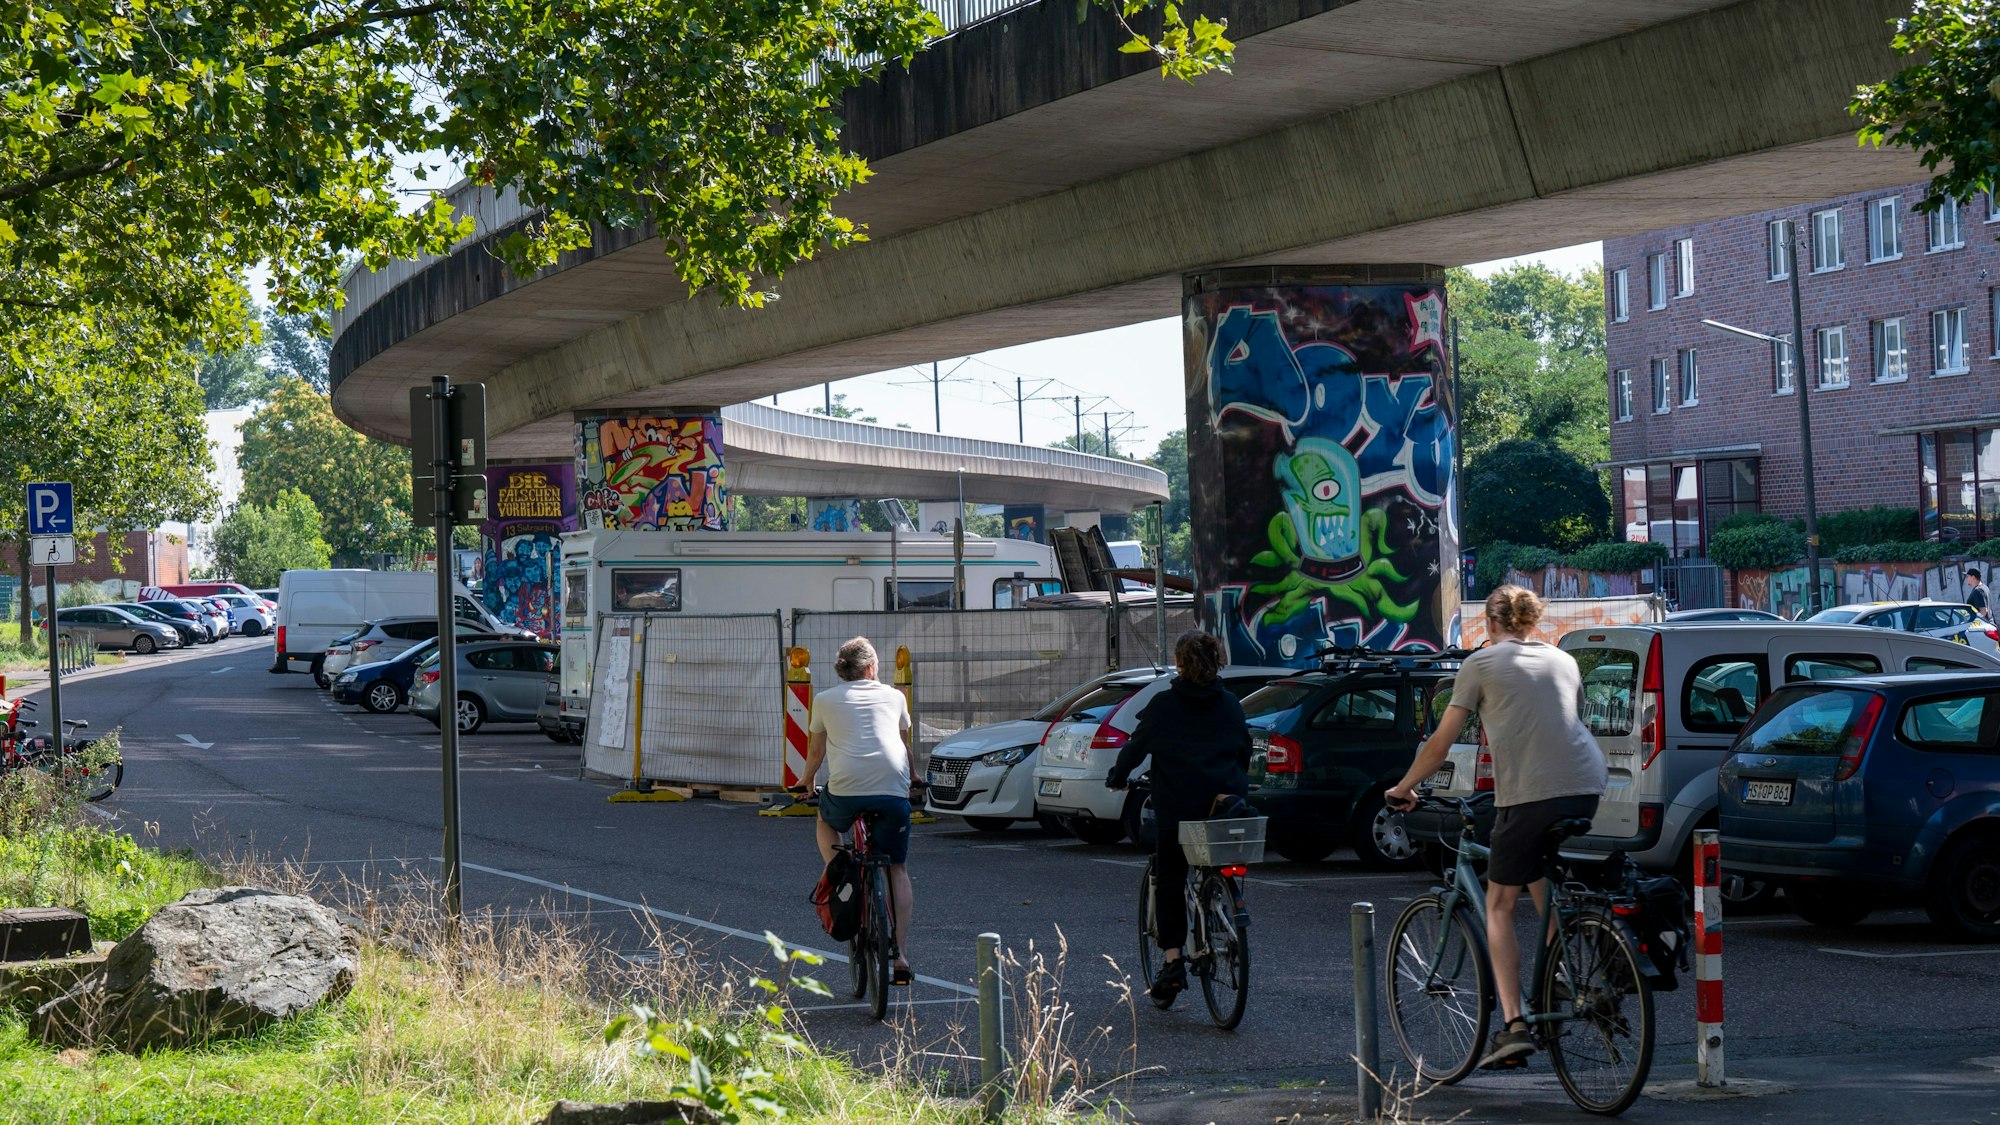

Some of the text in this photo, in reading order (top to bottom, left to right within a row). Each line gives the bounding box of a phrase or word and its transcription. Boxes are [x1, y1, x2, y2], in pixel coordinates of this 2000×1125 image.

[498, 488, 562, 502] FALSCHEN
[35, 489, 60, 529] P
[505, 525, 516, 537] 13
[1151, 549, 1157, 566] 3
[1748, 783, 1758, 798] HS
[1774, 785, 1789, 800] 861
